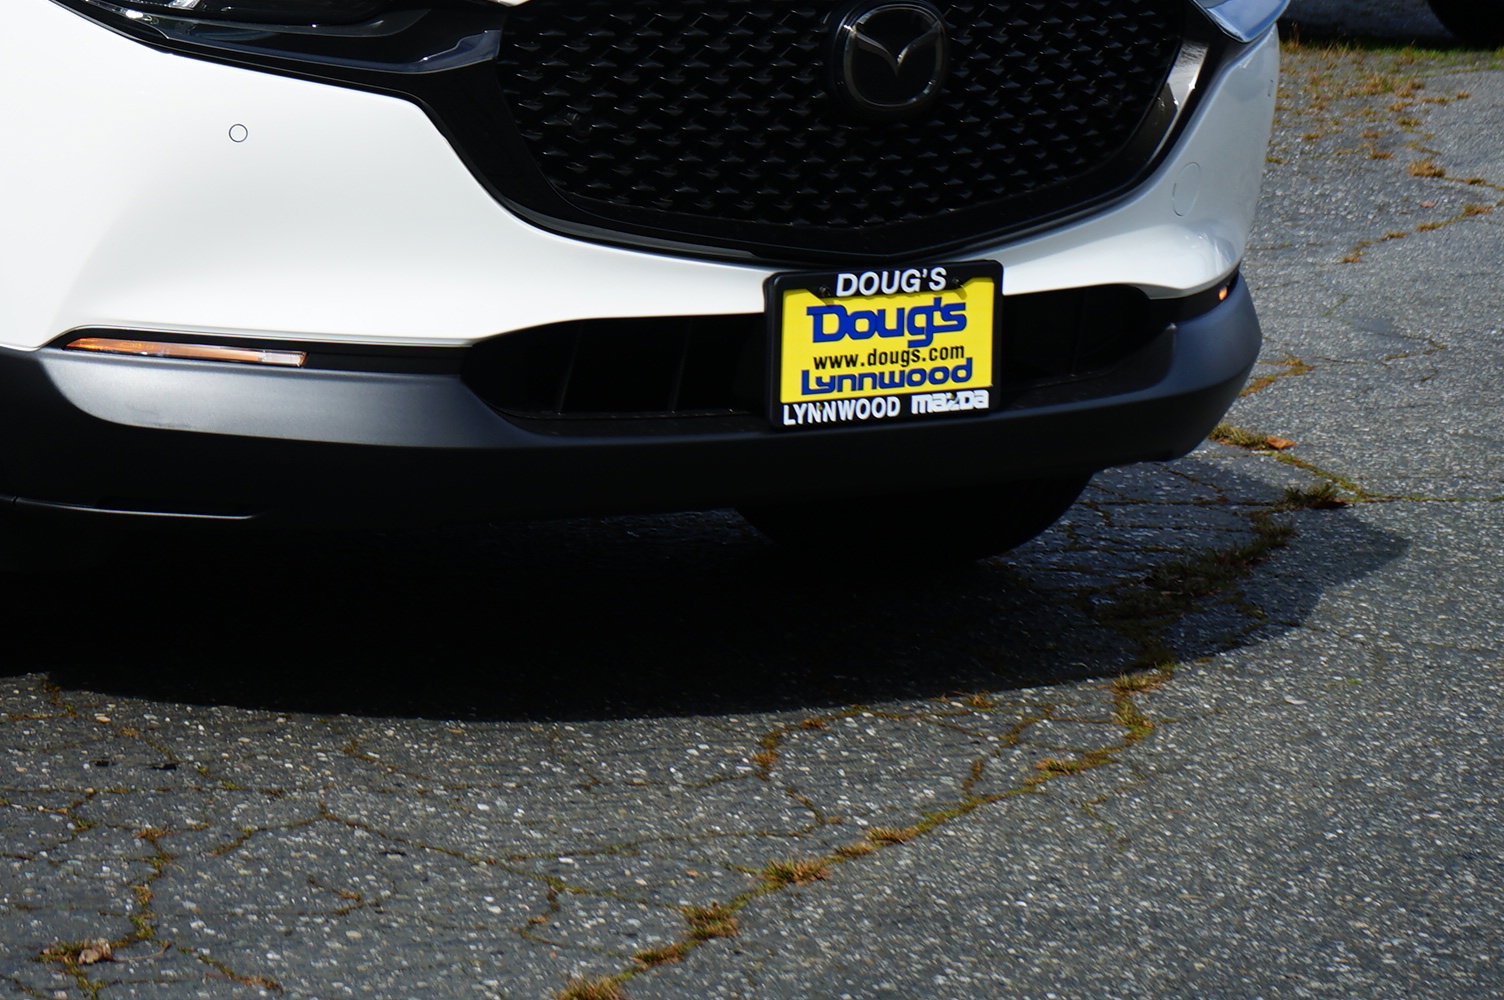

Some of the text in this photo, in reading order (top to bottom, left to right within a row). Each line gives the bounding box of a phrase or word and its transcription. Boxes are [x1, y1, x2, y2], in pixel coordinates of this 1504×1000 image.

[836, 267, 946, 297] DOUG'S
[806, 297, 967, 348] Doug's
[813, 345, 965, 369] www.dougs.com
[801, 357, 973, 396] Lynnwood
[782, 396, 901, 426] LYNNWOOD
